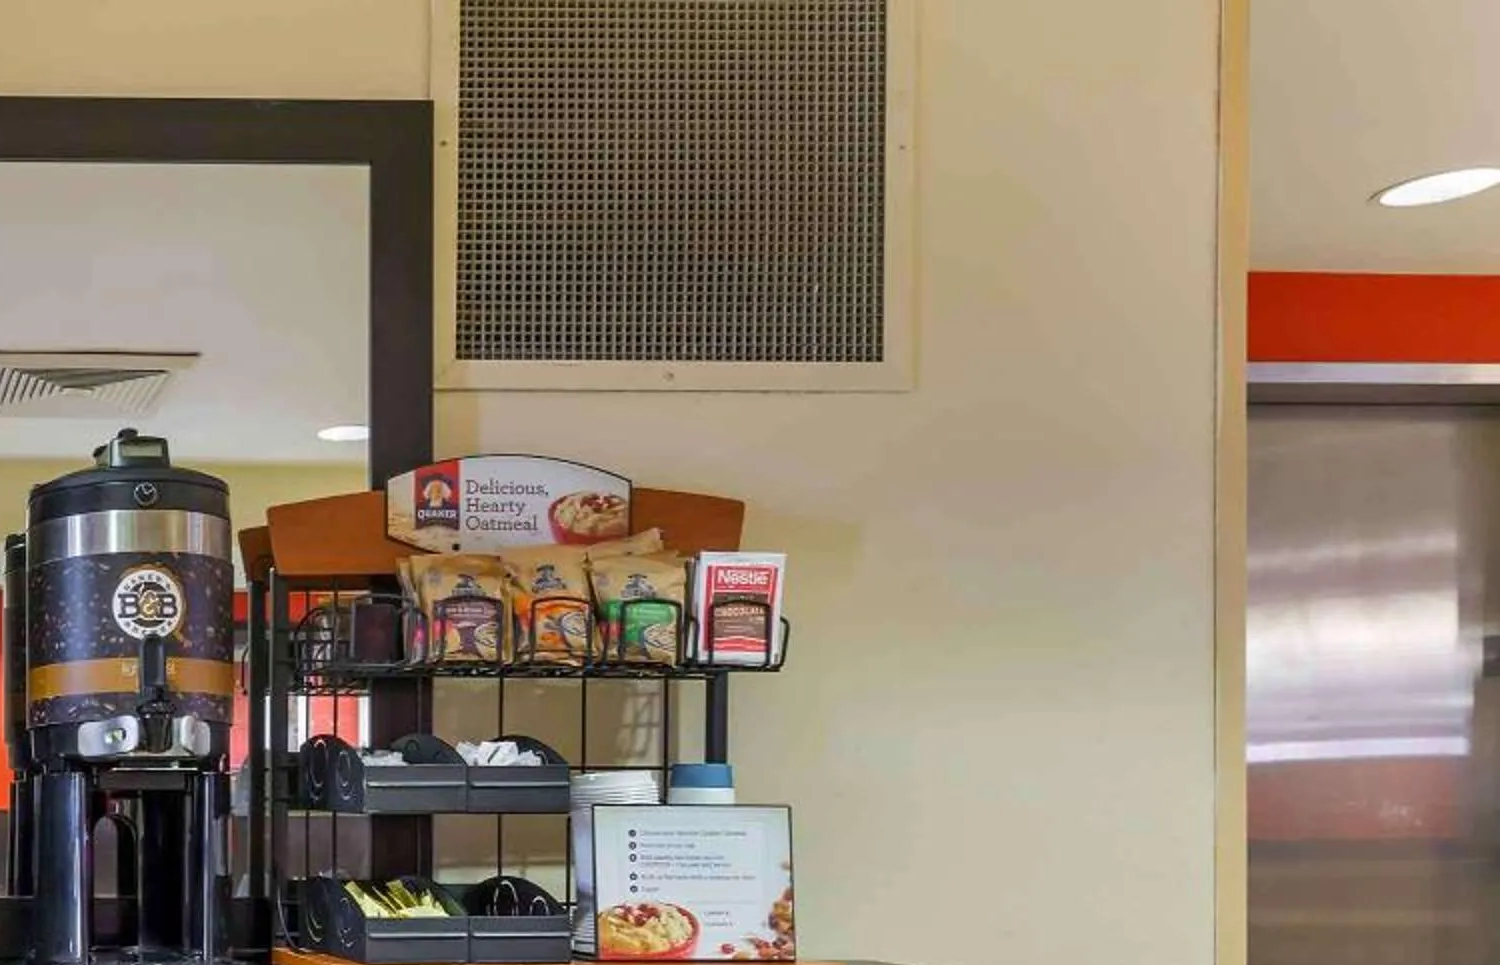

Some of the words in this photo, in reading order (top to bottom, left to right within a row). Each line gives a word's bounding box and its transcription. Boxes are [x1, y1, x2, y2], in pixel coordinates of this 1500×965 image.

[465, 478, 549, 497] Delicious,
[417, 508, 457, 520] QUAKER
[465, 498, 526, 516] Hearty
[465, 516, 538, 531] Oatmeal
[117, 590, 178, 619] B&B
